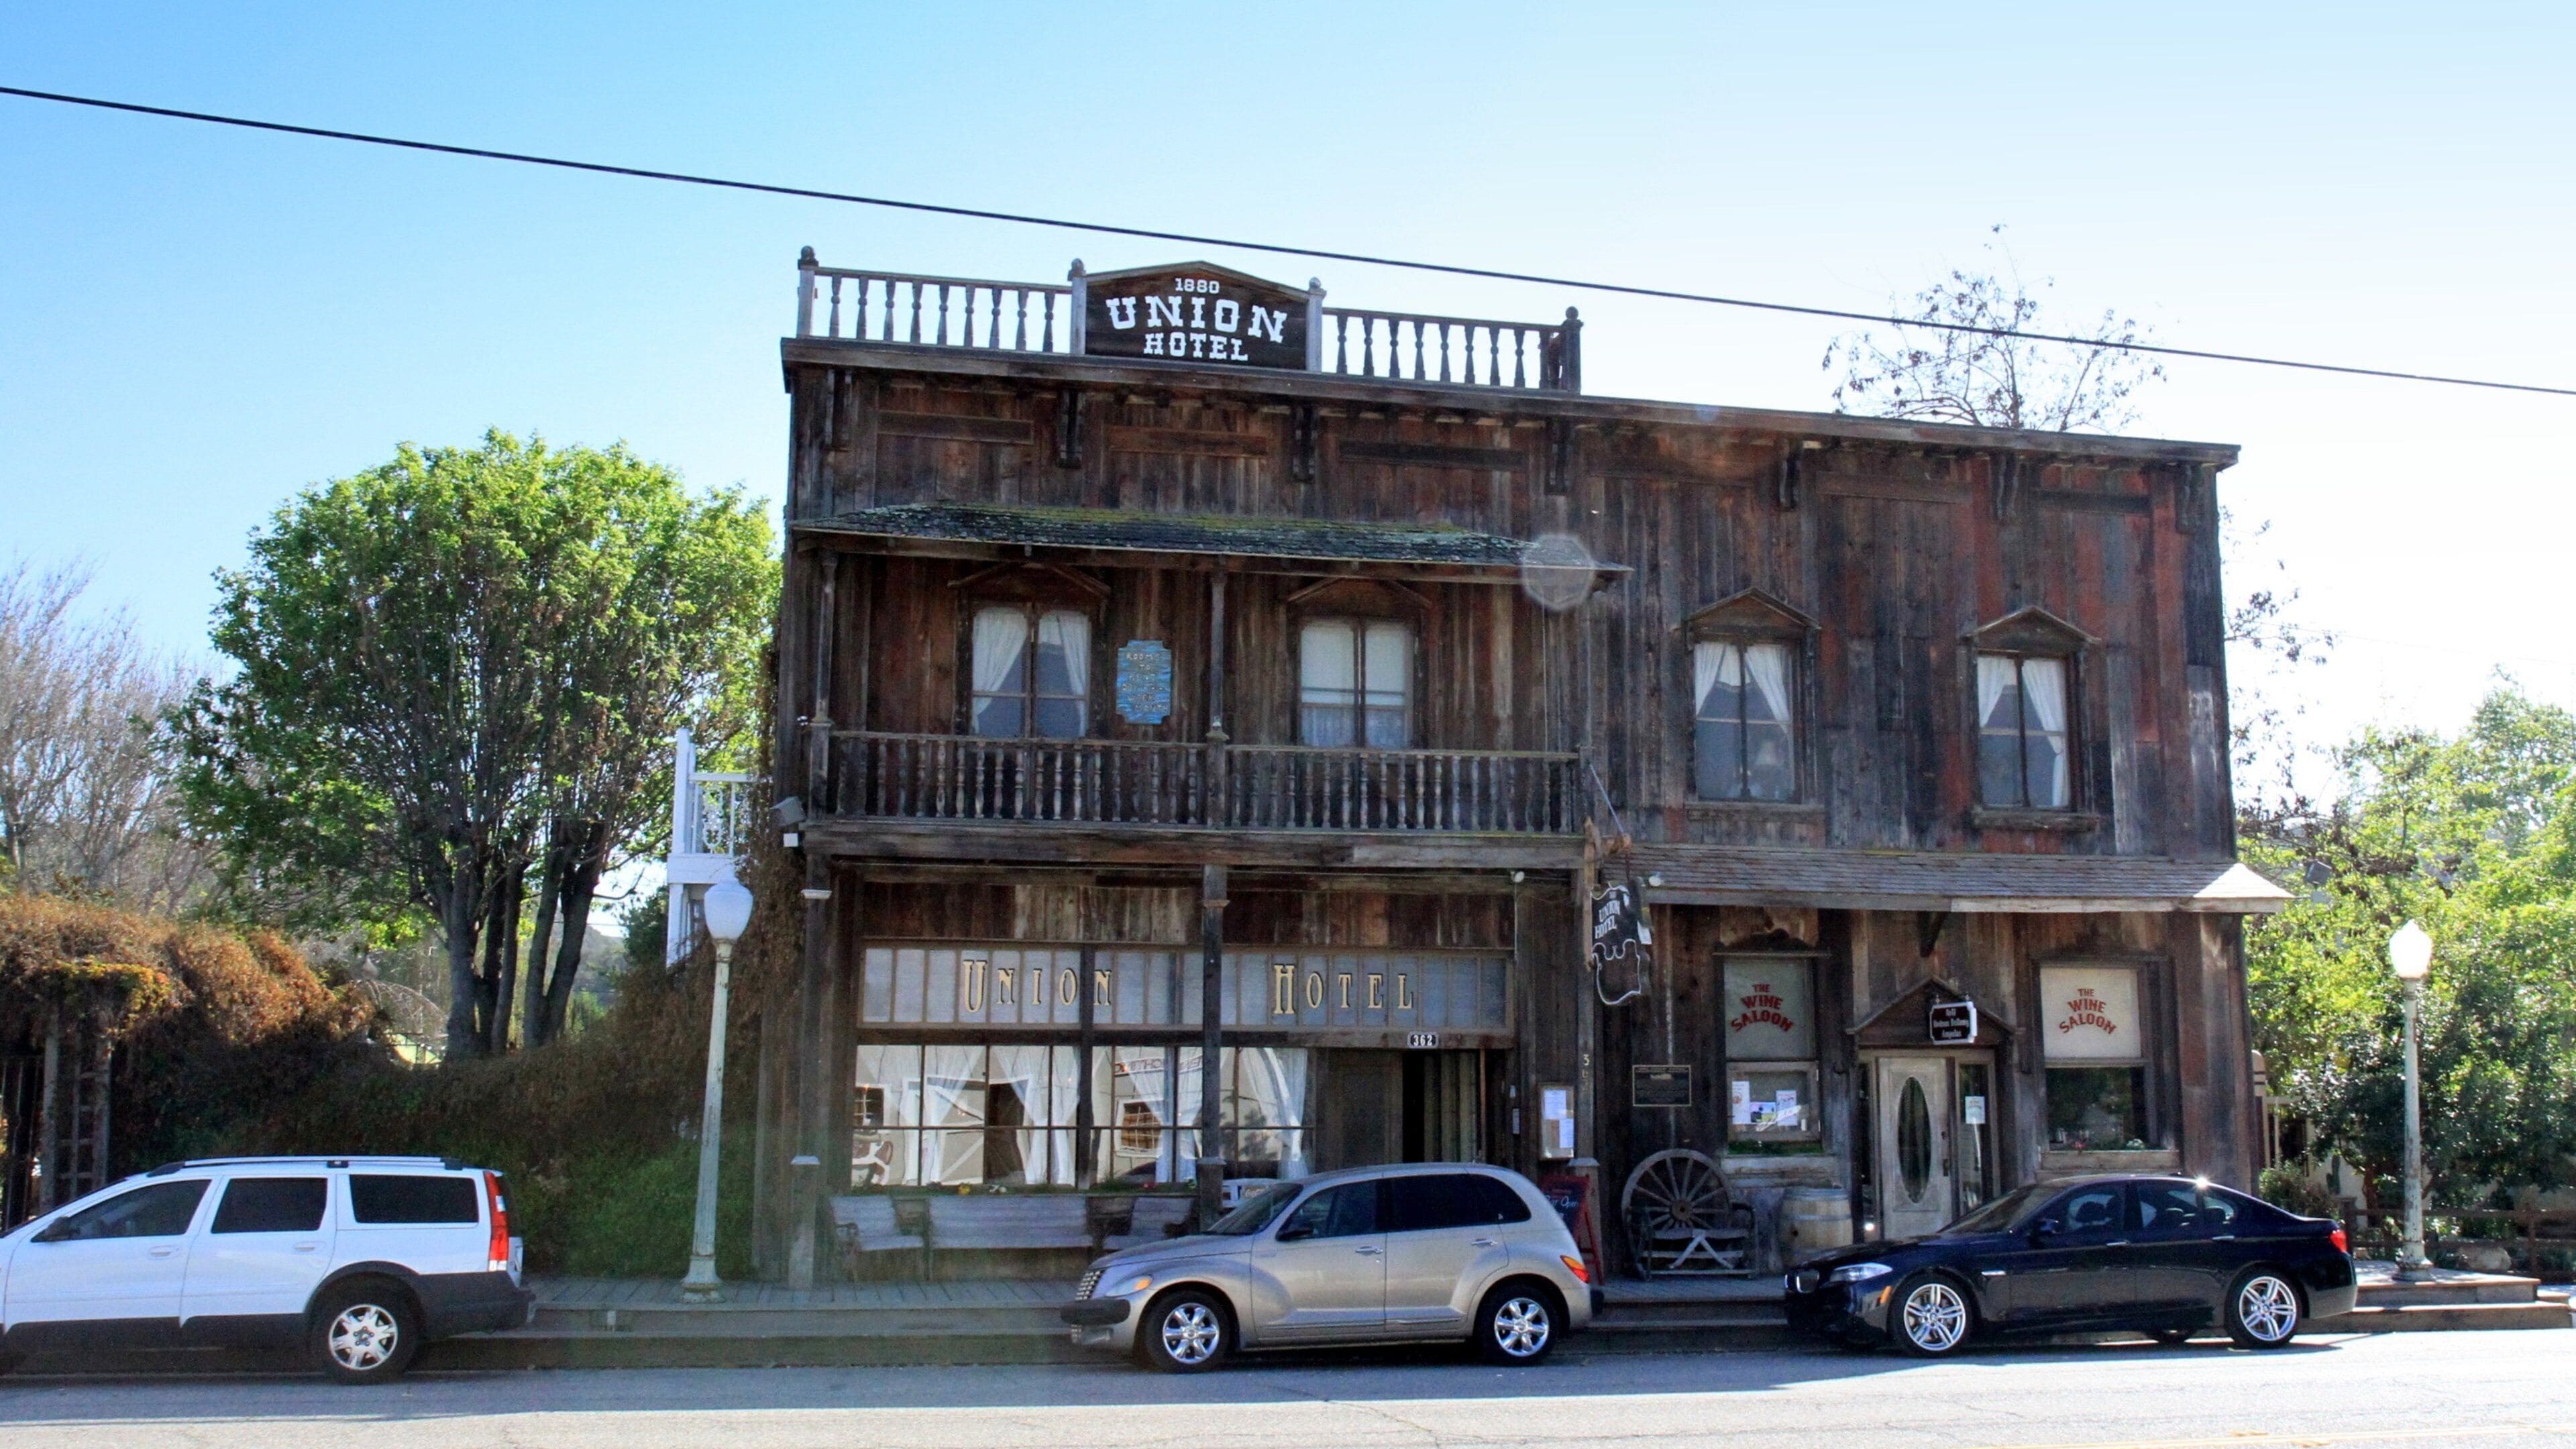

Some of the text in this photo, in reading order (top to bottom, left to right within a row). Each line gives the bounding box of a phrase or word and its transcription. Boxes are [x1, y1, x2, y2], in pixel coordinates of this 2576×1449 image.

[1175, 278, 1220, 294] 1880
[1106, 296, 1287, 343] UNION
[1143, 332, 1248, 362] HOTEL
[1126, 653, 1160, 661] ROOMS
[1595, 915, 1617, 939] HOTEL
[963, 959, 1413, 1014] UNION HOTEL
[1752, 983, 1770, 993] THE
[2078, 988, 2094, 997] THE
[1741, 995, 1783, 1010] WINE
[2067, 998, 2106, 1014] WINE
[1731, 1010, 1794, 1032] SALOON
[2059, 1013, 2116, 1034] SALOON
[1413, 1034, 1433, 1046] 362
